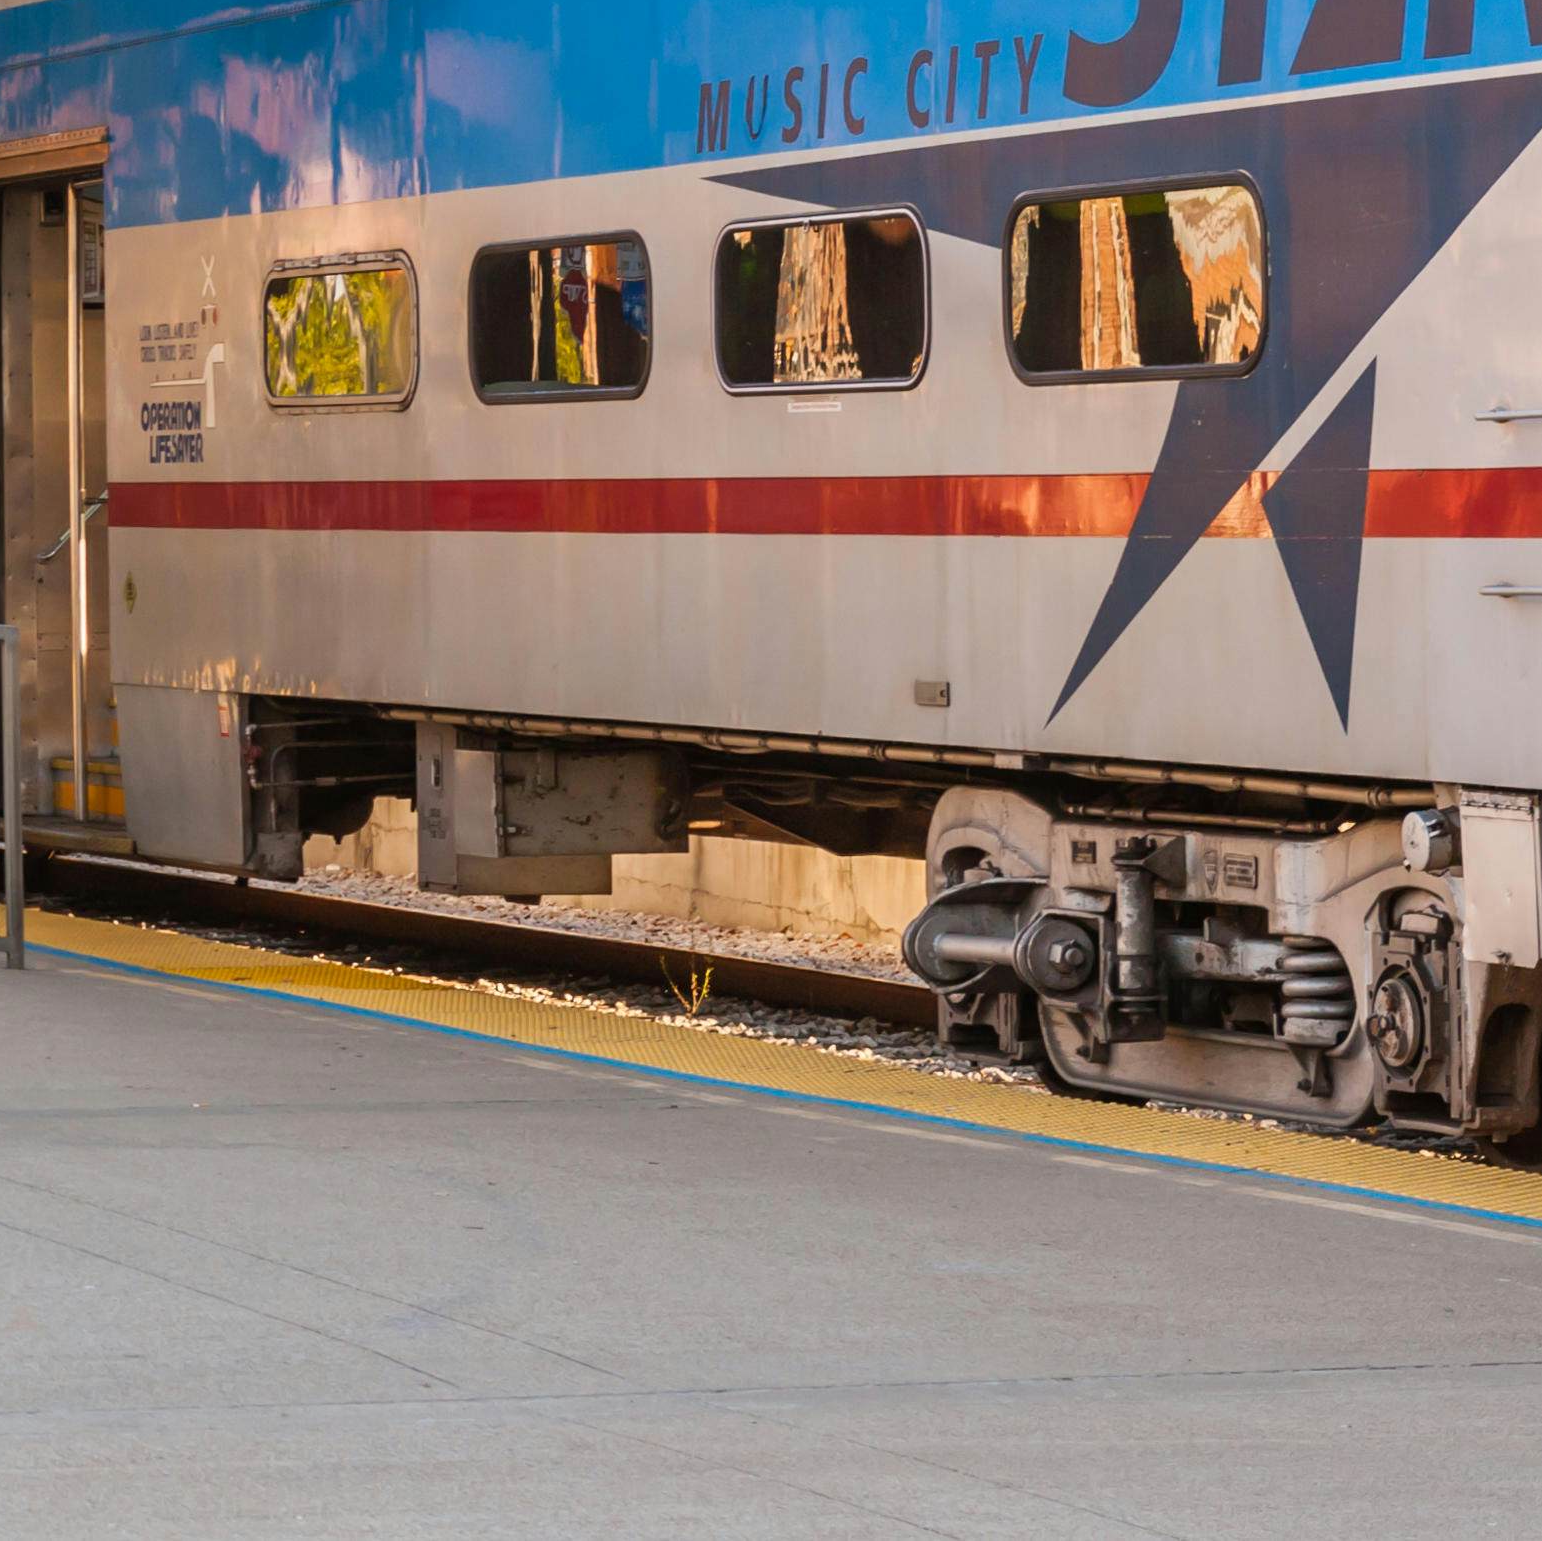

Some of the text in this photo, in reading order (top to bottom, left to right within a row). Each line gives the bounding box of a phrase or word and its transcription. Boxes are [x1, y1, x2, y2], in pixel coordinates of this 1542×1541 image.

[696, 57, 868, 154] MUSIC
[906, 33, 1044, 129] CITY
[141, 401, 202, 431] OPERATION
[150, 432, 204, 464] LIFESAVER
